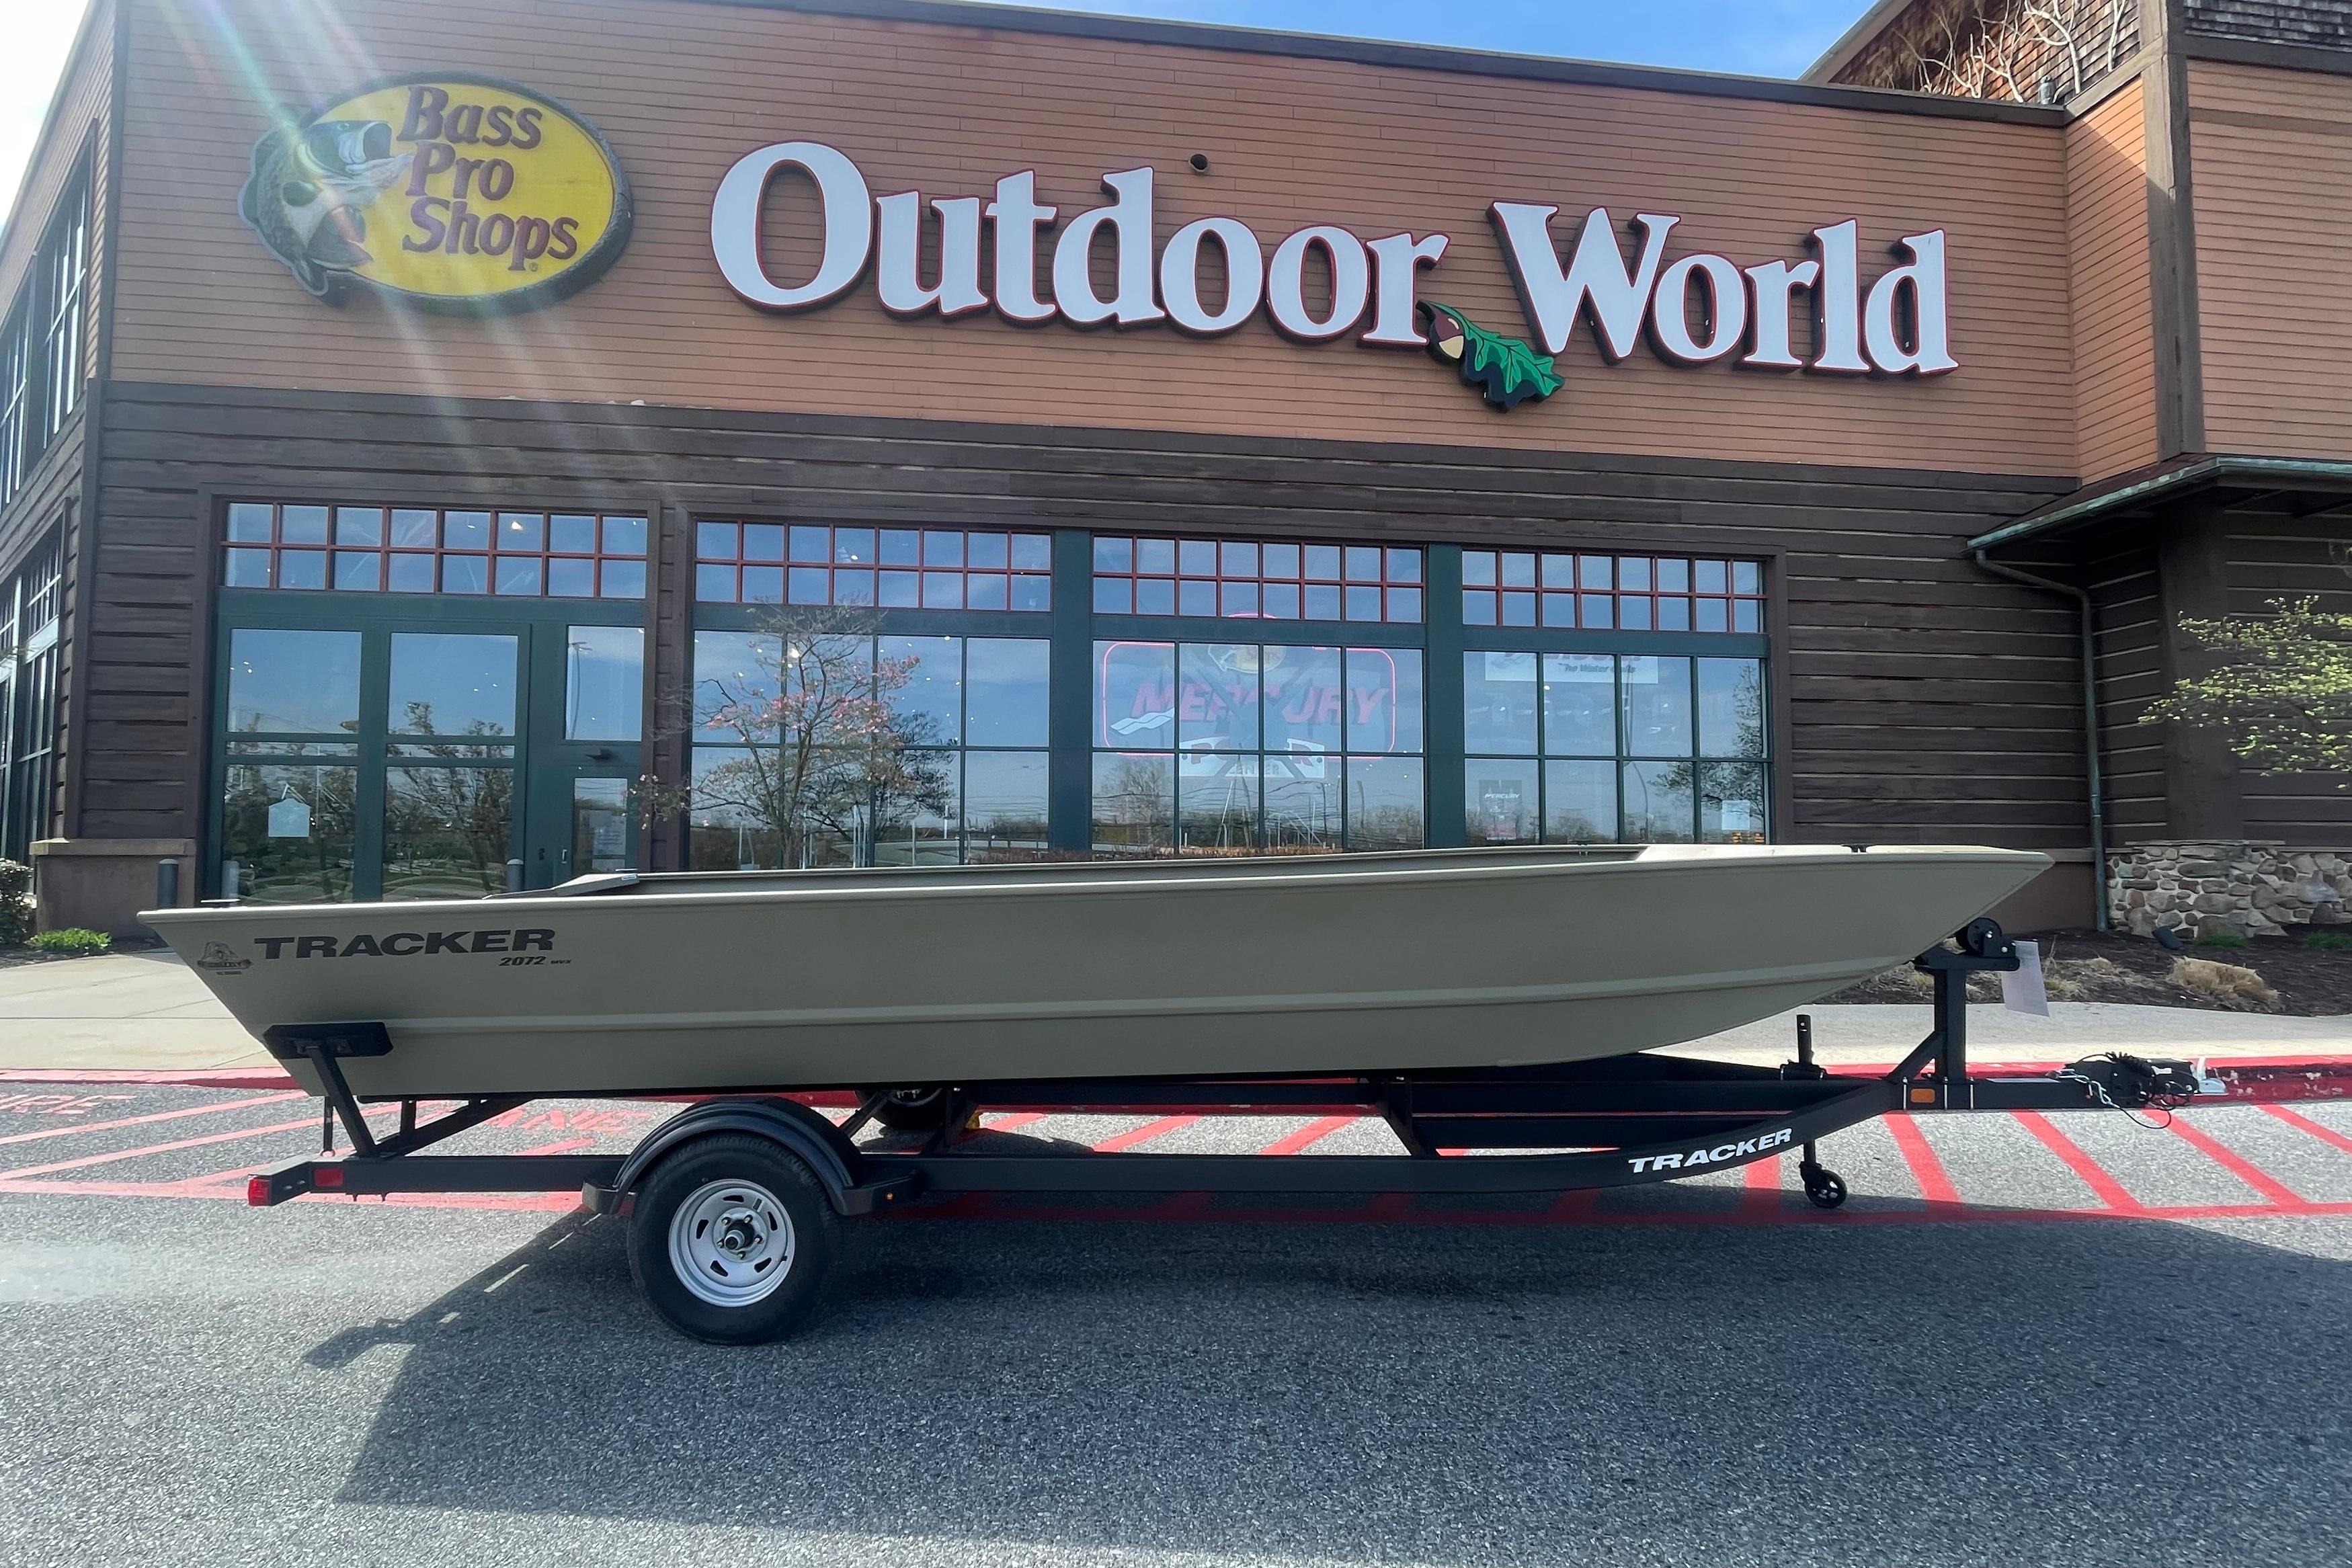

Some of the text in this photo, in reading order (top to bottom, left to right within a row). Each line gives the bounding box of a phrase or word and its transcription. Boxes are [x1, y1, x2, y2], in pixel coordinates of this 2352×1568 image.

[396, 85, 542, 150] Bass
[405, 141, 514, 201] Pro
[403, 196, 579, 271] Shops
[710, 140, 1959, 378] Outdoor World
[254, 928, 556, 960] TRACKER
[498, 956, 547, 966] 2072
[1628, 1128, 1793, 1173] TRACKER
